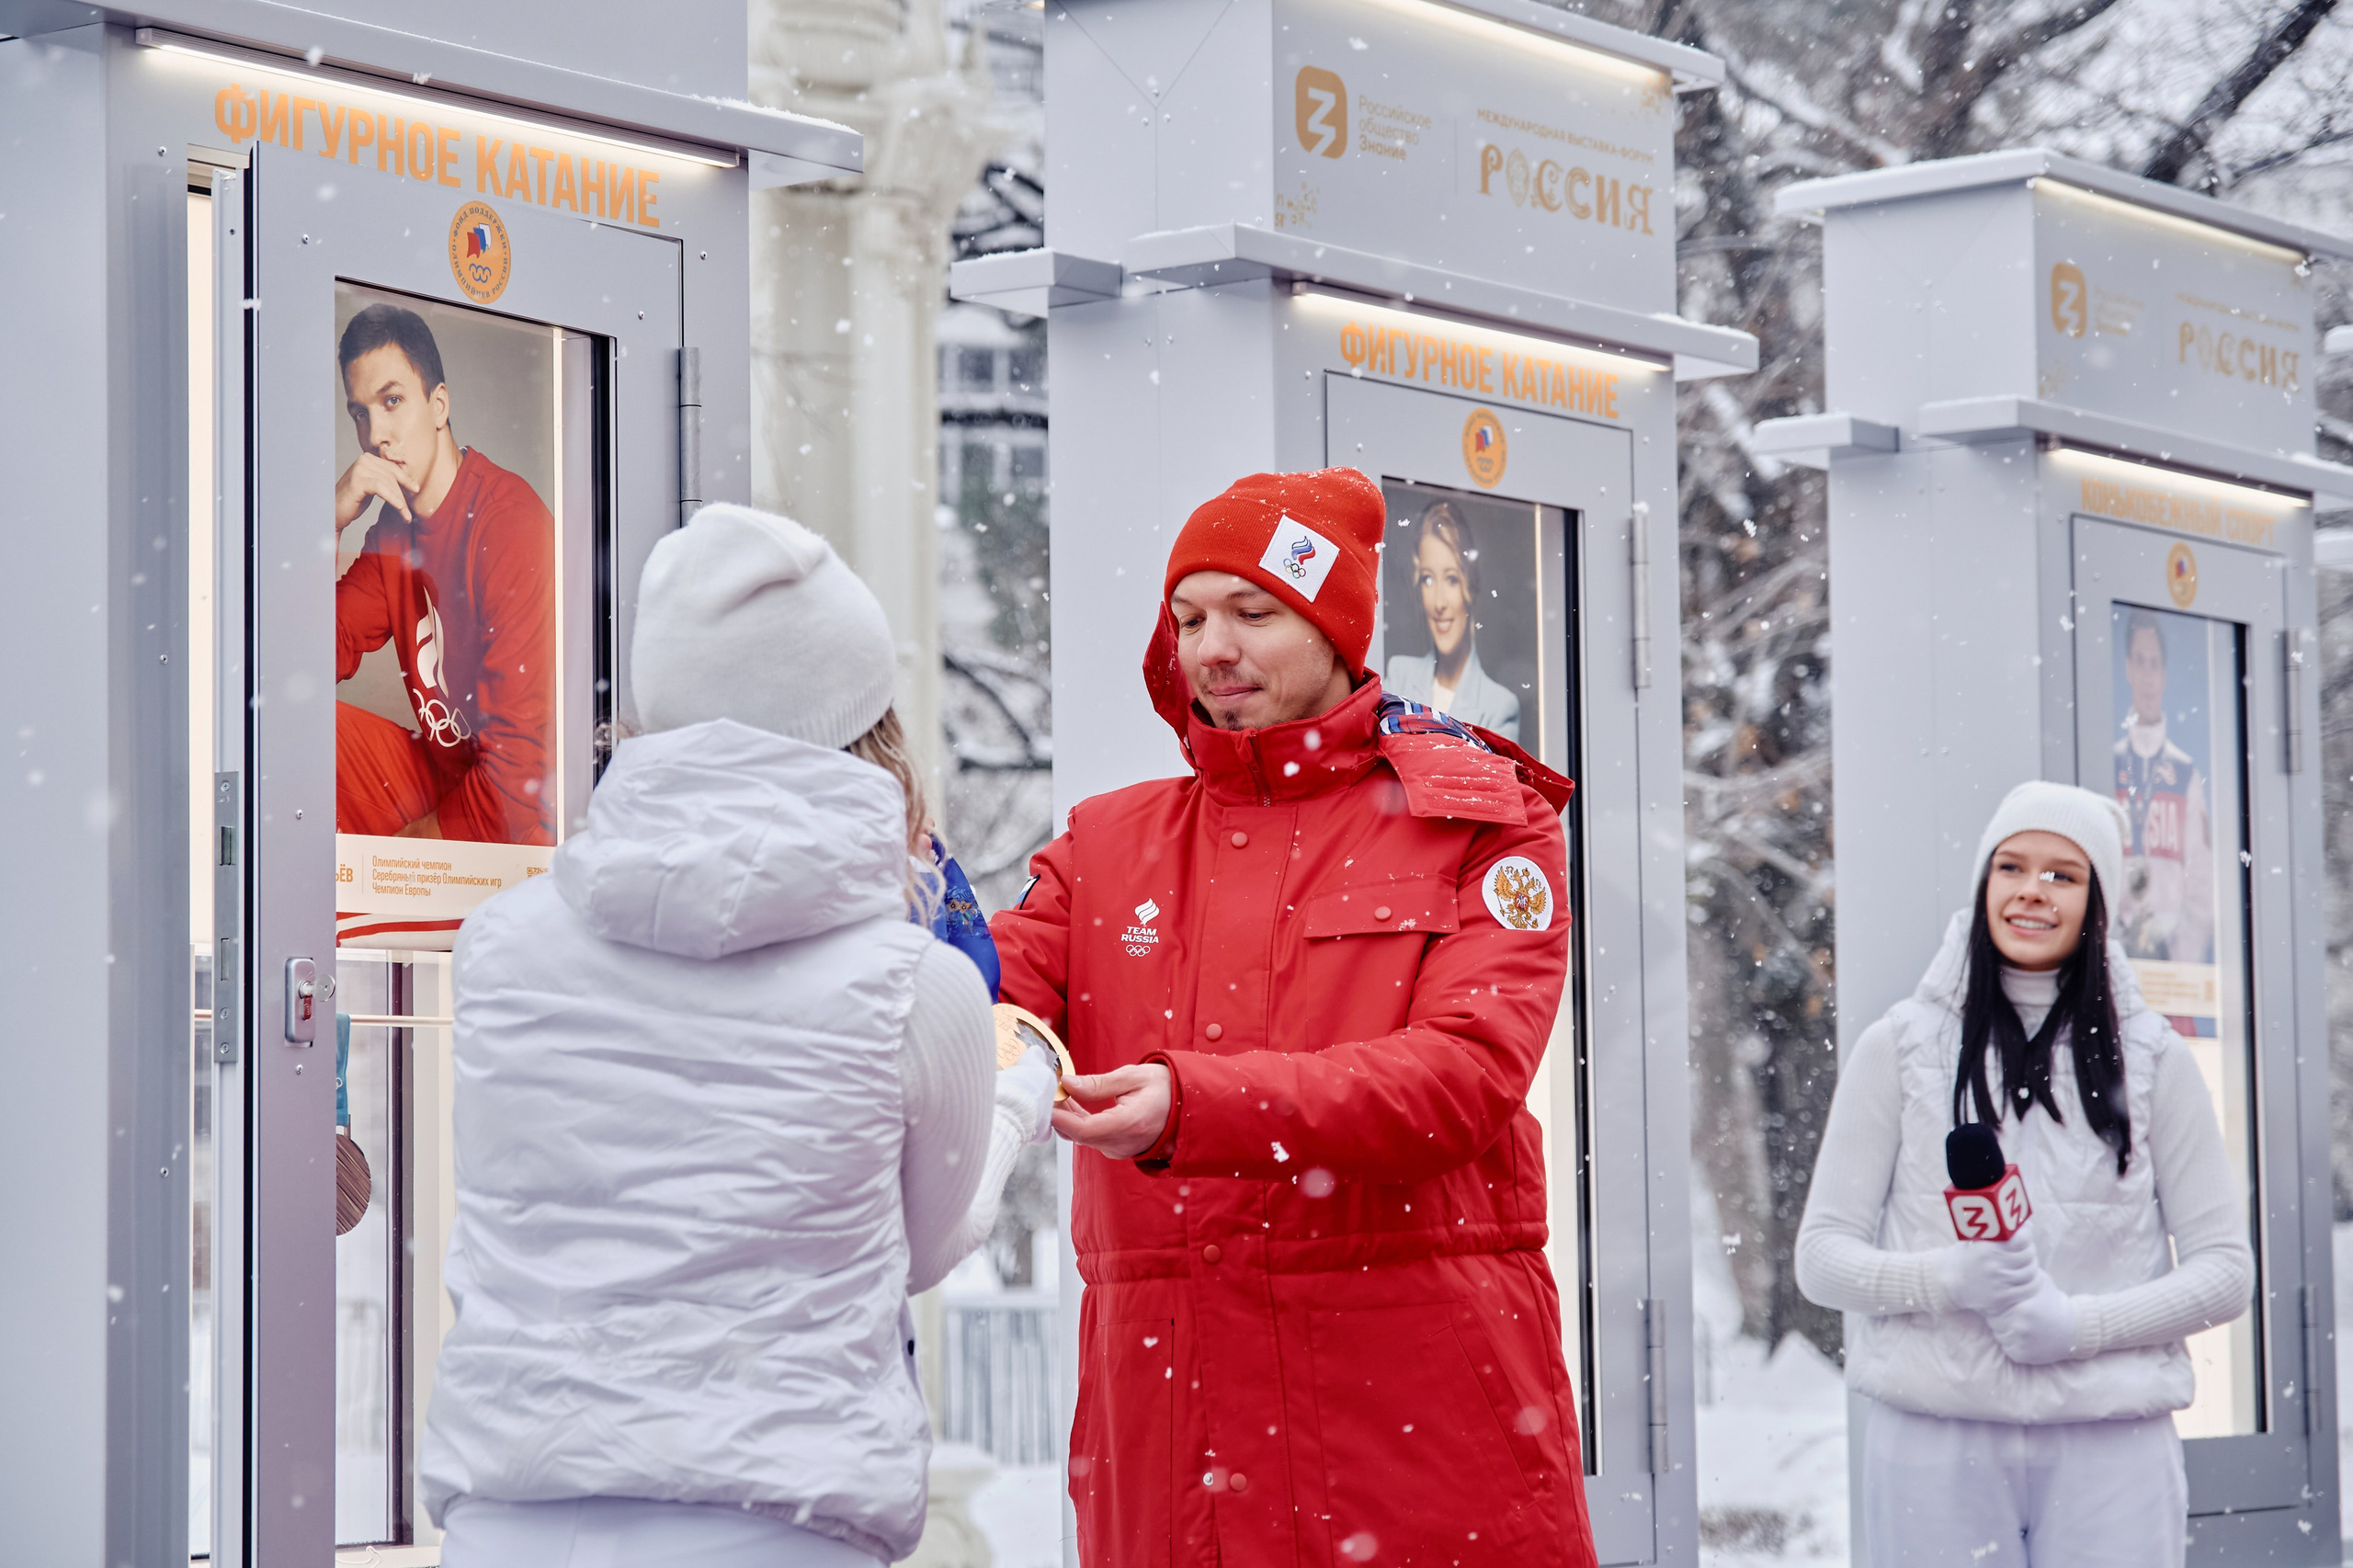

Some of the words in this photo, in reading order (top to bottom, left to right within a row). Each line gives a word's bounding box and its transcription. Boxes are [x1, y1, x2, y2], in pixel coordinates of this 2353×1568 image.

[1358, 95, 1432, 130] Российское
[1358, 118, 1419, 146] общество
[1359, 134, 1407, 161] Знание
[214, 83, 460, 188] ФИГУРНОЕ
[476, 134, 660, 229] КАТАНИЕ
[1478, 143, 1654, 236] РОССИЯ
[453, 211, 469, 238] ФОНД
[470, 207, 507, 249] ПОДДЕРЖКИ
[491, 257, 508, 295] РОССИИ
[1340, 320, 1494, 393] ФИГУРНОЕ
[1503, 350, 1620, 419] КАТАНИЕ
[2178, 321, 2300, 393] РОССИЯ
[372, 855, 420, 869] Олимпийский
[421, 861, 452, 871] чемпион
[372, 881, 404, 895] Чемпион
[404, 883, 431, 897] Европы
[416, 872, 441, 885] призёр
[442, 872, 489, 886] Олимпийских
[490, 877, 502, 889] игр
[1120, 934, 1159, 944] RUSSIA
[1126, 926, 1157, 936] TEAM
